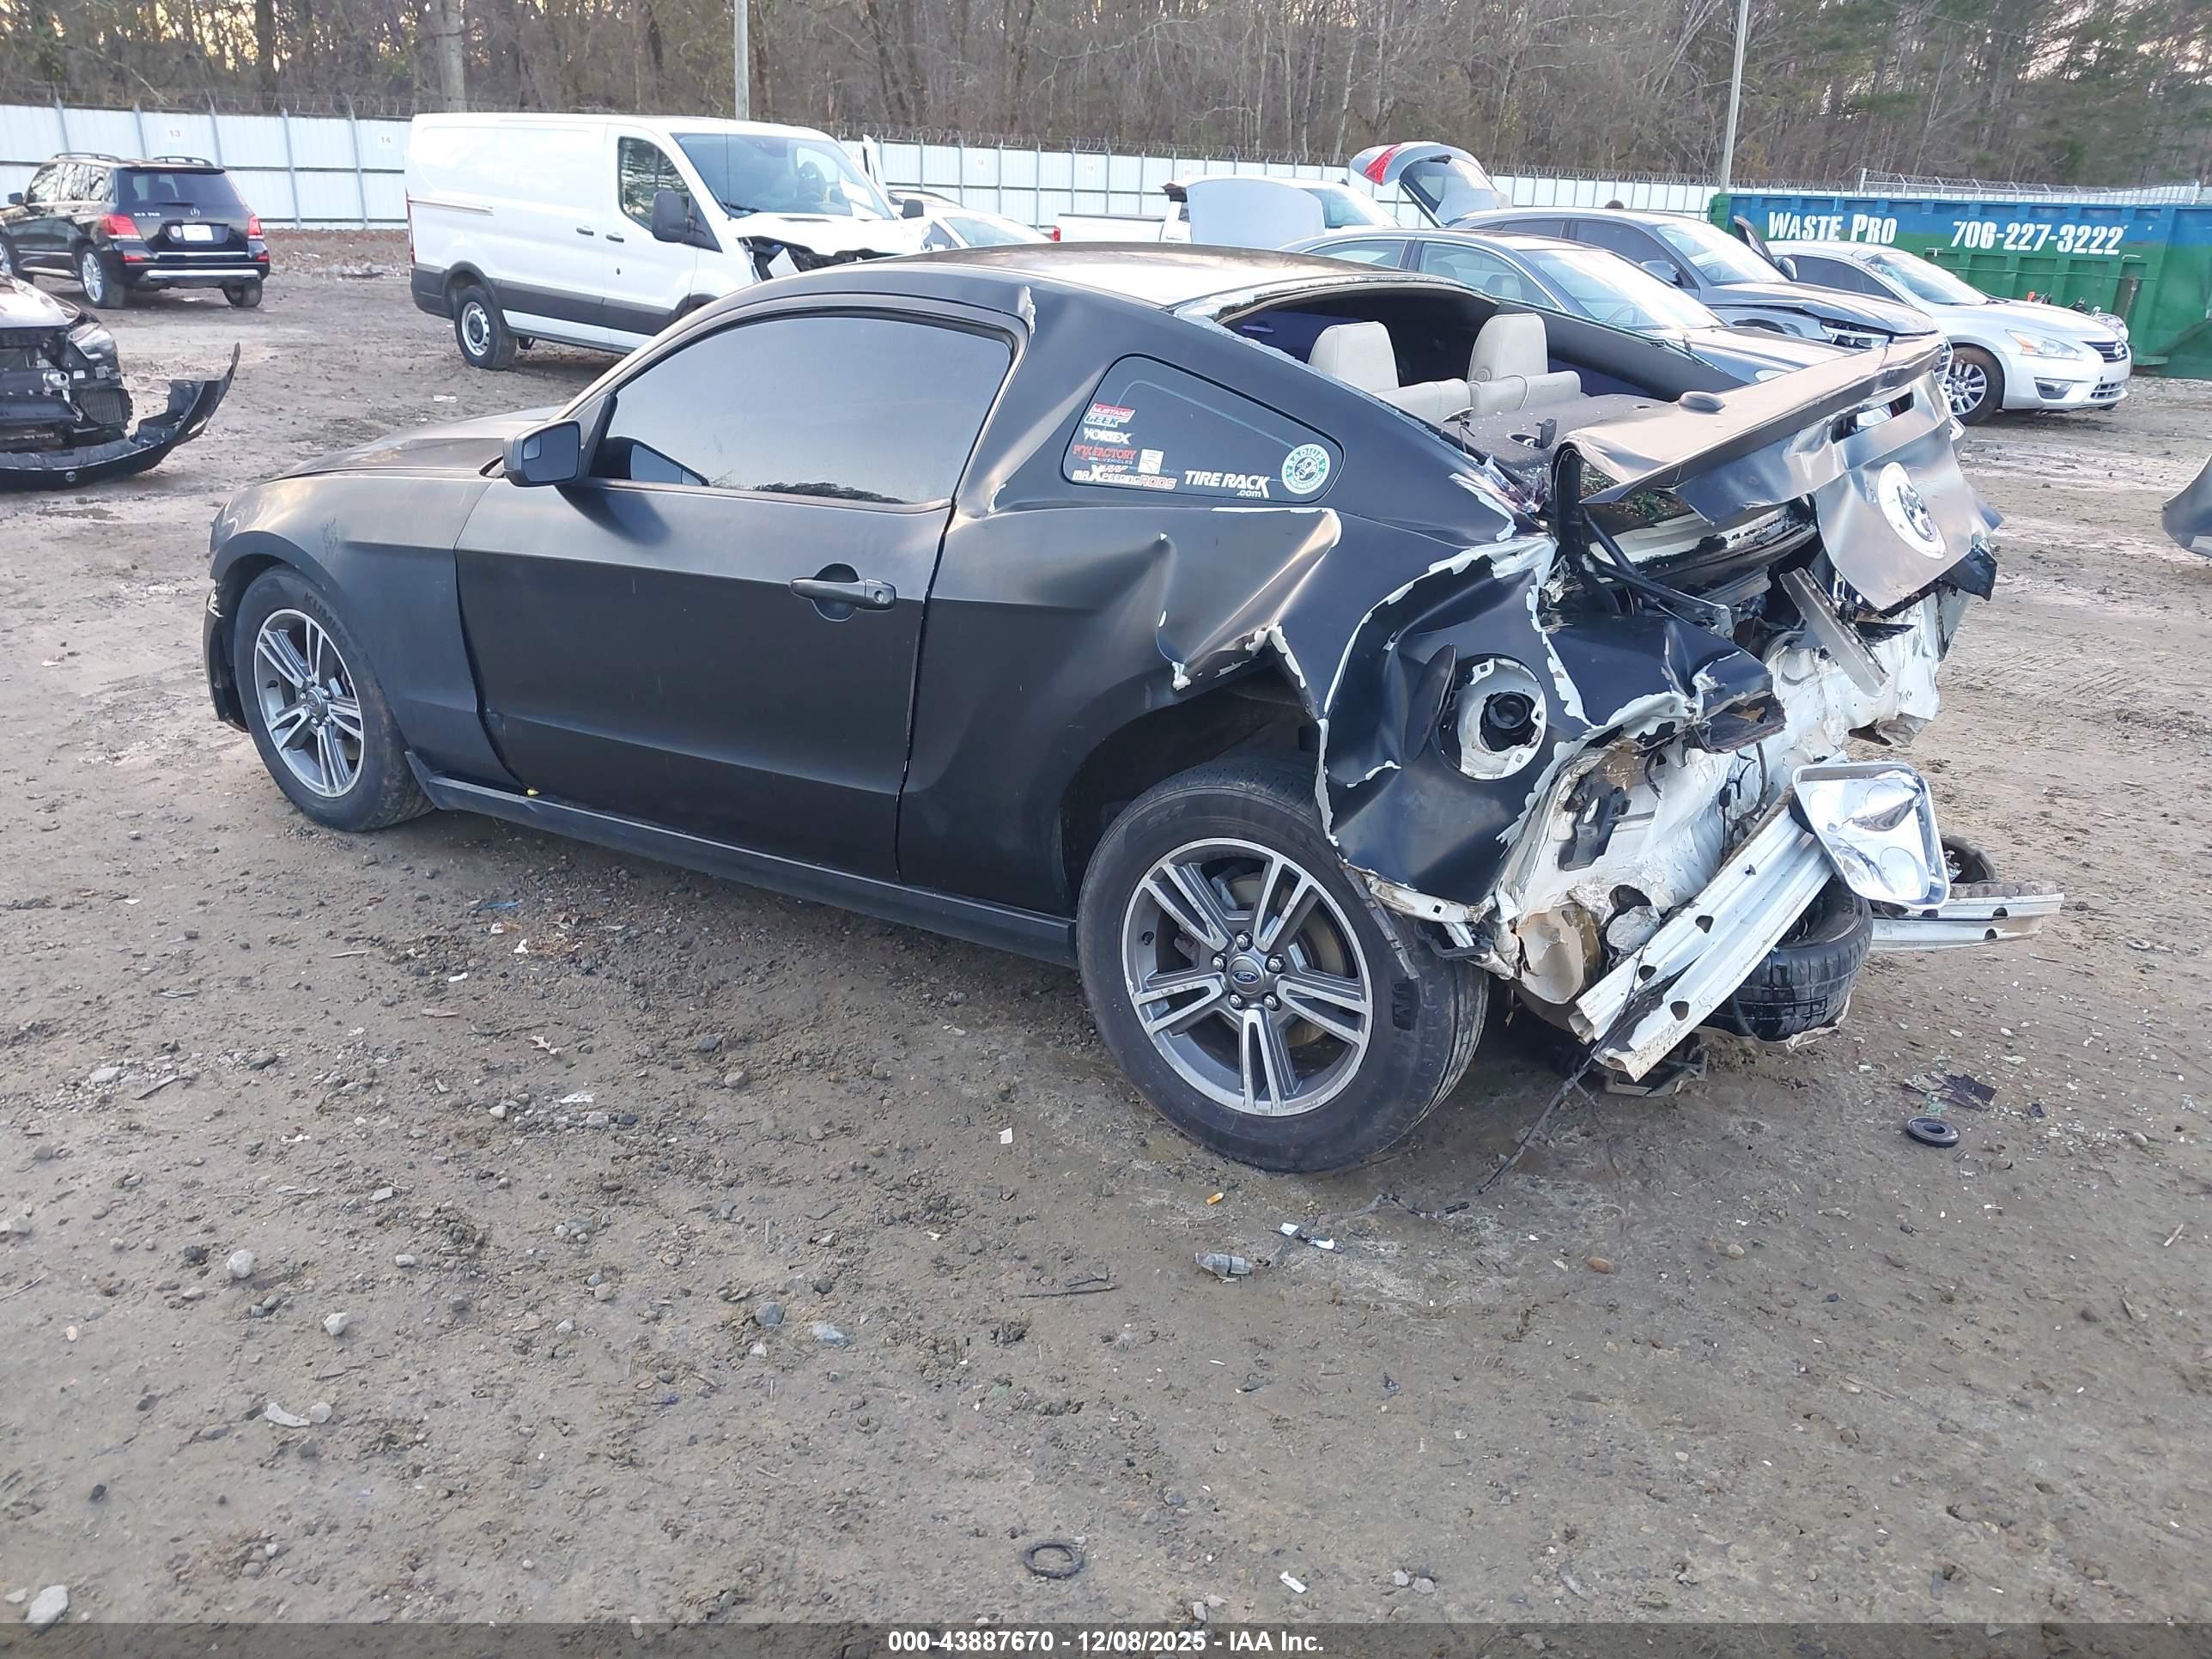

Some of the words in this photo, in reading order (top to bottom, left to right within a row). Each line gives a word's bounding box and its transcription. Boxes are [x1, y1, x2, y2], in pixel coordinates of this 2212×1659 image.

[1768, 211, 1843, 241] WASTE
[1850, 214, 1898, 244] PRO
[1950, 220, 2124, 256] 706-227-3222
[1085, 415, 1119, 426] GEEK
[1093, 447, 1138, 460] FACTORY
[1288, 447, 1326, 466] RADIUM
[1184, 470, 1223, 487] TIRE
[1221, 473, 1270, 498] RACK
